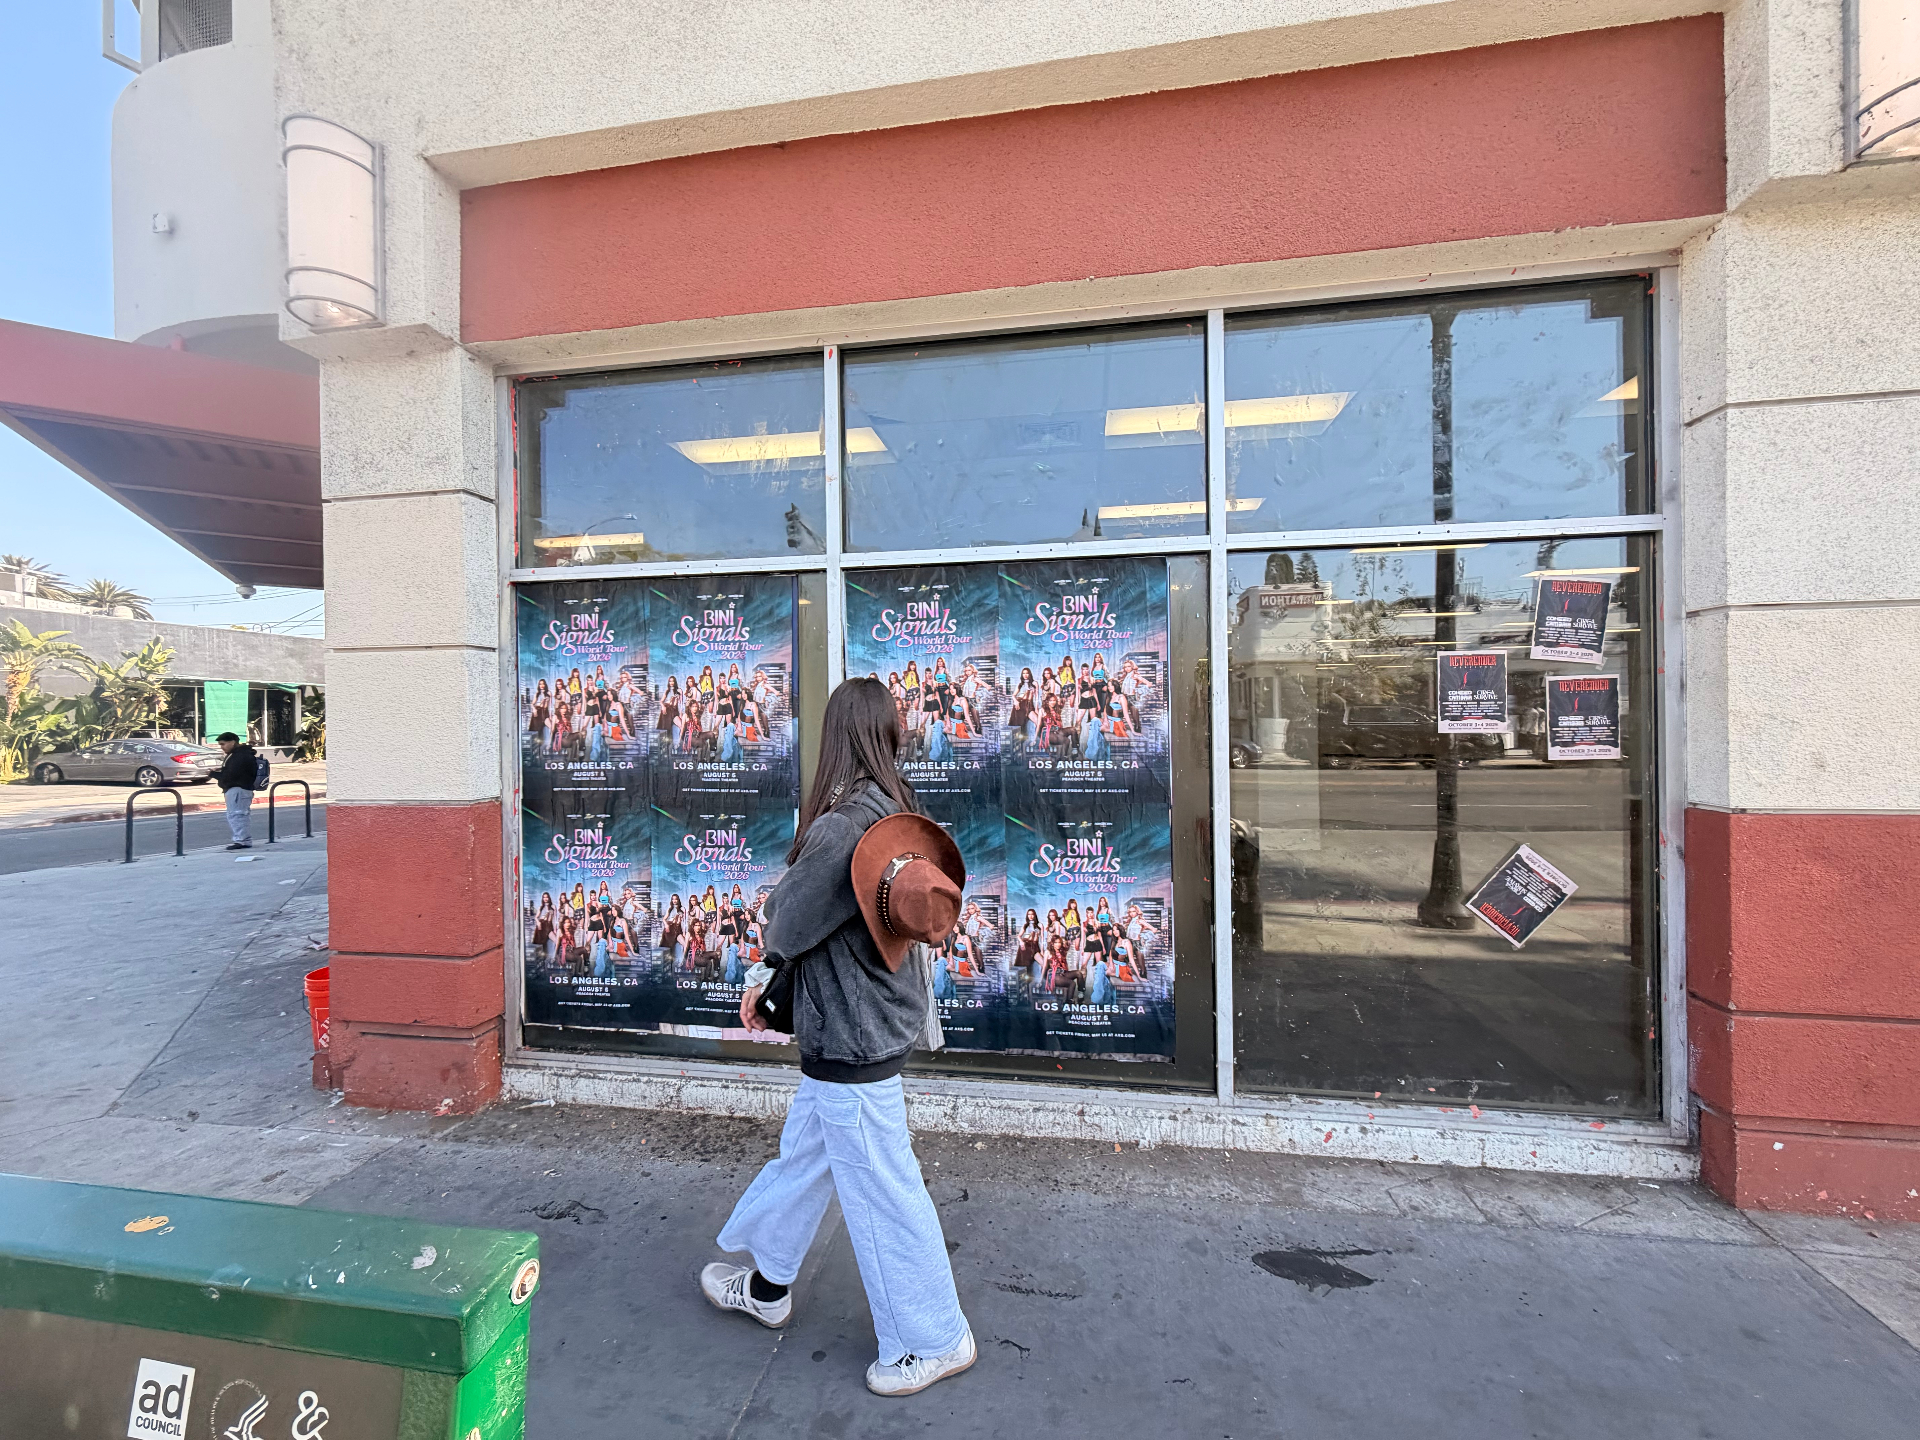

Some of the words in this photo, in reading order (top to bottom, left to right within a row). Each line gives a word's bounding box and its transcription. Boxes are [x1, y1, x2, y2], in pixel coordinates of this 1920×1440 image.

[907, 593, 940, 620] BINI
[1063, 586, 1100, 613] BINI
[571, 606, 599, 630] BINI
[704, 602, 736, 626] BINI
[1024, 602, 1117, 642] Signals
[541, 620, 614, 656] Signals
[671, 615, 750, 653] Signals
[871, 608, 957, 647] Signals
[1068, 630, 1102, 640] World
[1106, 629, 1133, 639] Tour
[577, 645, 603, 654] World
[605, 644, 628, 653] Tour
[710, 642, 738, 651] World
[741, 642, 764, 651] Tour
[914, 635, 945, 645] World
[947, 634, 973, 644] Tour
[545, 762, 564, 770] LOS
[567, 762, 616, 770] ANGELES,
[673, 762, 694, 770] LOS
[697, 762, 749, 771] ANGELES,
[752, 763, 768, 771] CA
[903, 762, 960, 770] ANGELES,
[963, 761, 980, 769] CA
[1028, 761, 1053, 769] LOS
[1056, 761, 1117, 770] ANGELES,
[1121, 761, 1139, 769] CA
[575, 821, 604, 844] BINI
[705, 822, 737, 846] BINI
[1067, 830, 1103, 856] BINI
[545, 833, 618, 871] Signals
[674, 834, 753, 872] Signals
[581, 860, 607, 869] World
[609, 860, 631, 869] Tour
[712, 863, 740, 871] World
[743, 863, 767, 872] Tour
[1029, 843, 1121, 885] Signals
[1074, 874, 1108, 883] World
[1110, 873, 1138, 884] Tour
[549, 976, 569, 984] LOS
[571, 977, 621, 986] ANGELES,
[623, 978, 638, 986] CA
[676, 980, 697, 989] LOS
[935, 999, 963, 1008] LES,
[966, 999, 984, 1008] CA
[1034, 1002, 1059, 1011] LOS
[1062, 1003, 1124, 1015] ANGELES,
[1127, 1005, 1146, 1015] CA
[138, 1374, 188, 1421] ad
[135, 1415, 182, 1437] COUNCIL
